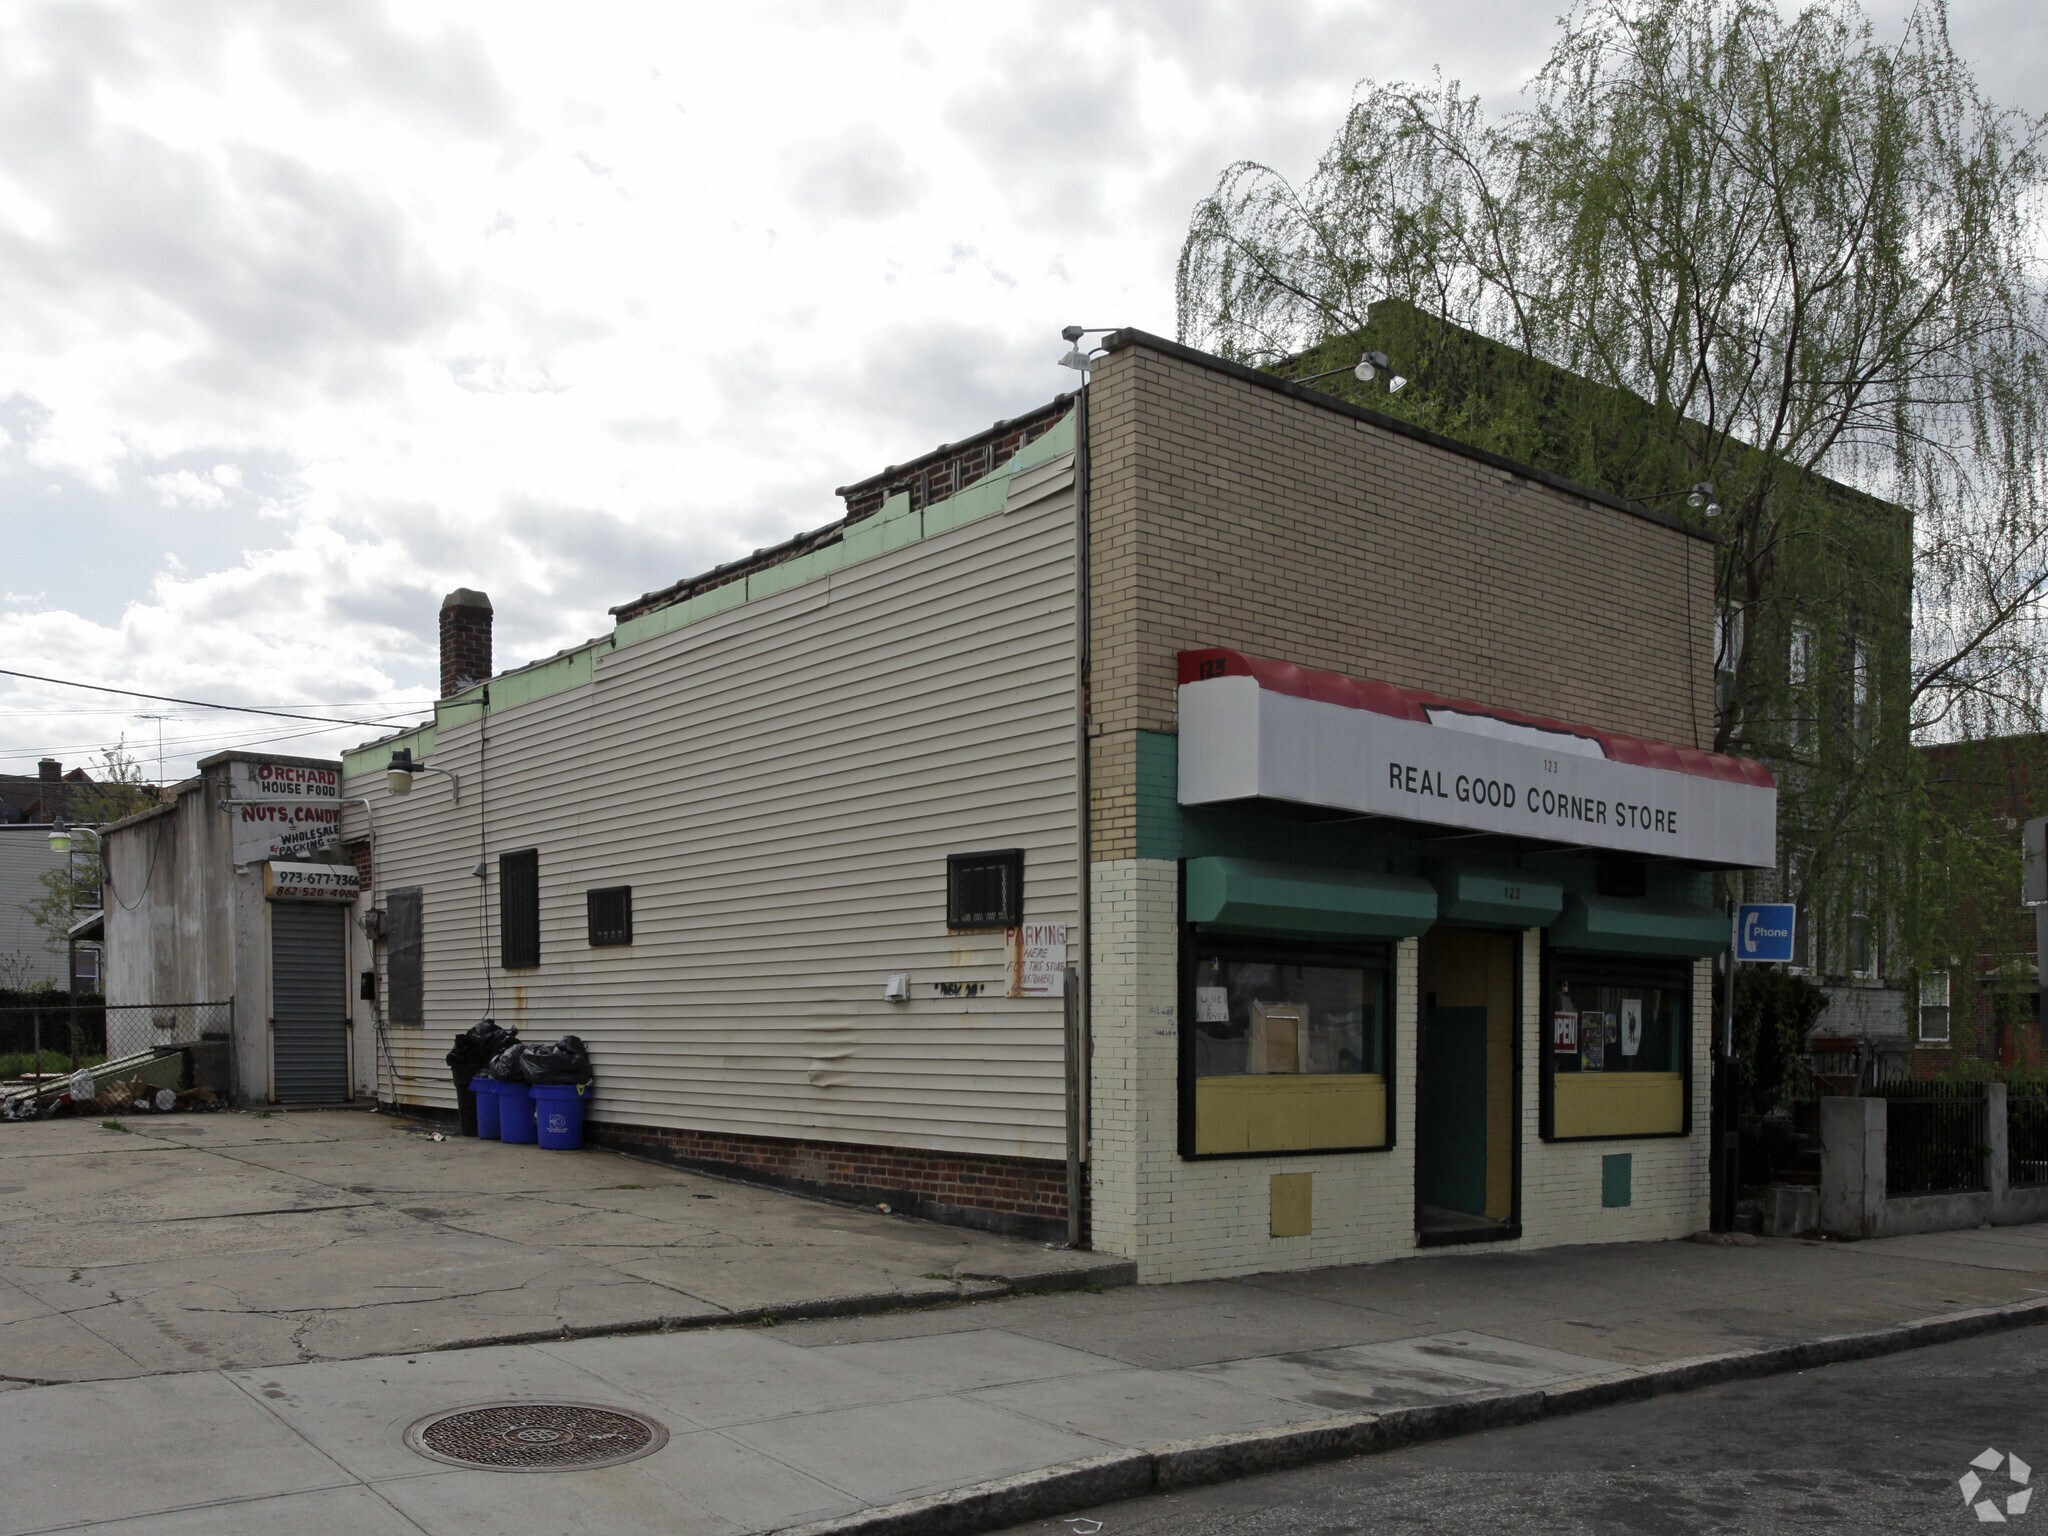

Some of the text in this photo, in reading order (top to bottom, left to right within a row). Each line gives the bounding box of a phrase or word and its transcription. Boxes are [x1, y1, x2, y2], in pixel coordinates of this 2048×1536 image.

[1543, 760, 1558, 773] 123
[258, 764, 335, 785] ORCHARD
[262, 781, 335, 797] HOUSE FOOD
[1389, 762, 1677, 834] REAL GOOD CORNER STORE
[242, 807, 288, 822] NUTS
[295, 807, 339, 824] CANDY
[281, 825, 339, 845] WHOLESALE
[280, 840, 324, 854] PACKING
[1504, 886, 1520, 900] 123
[1006, 925, 1065, 946] PARKING
[1754, 927, 1788, 938] Phone
[1024, 948, 1048, 958] HERE
[1007, 961, 1065, 973] FOR THIS STORE
